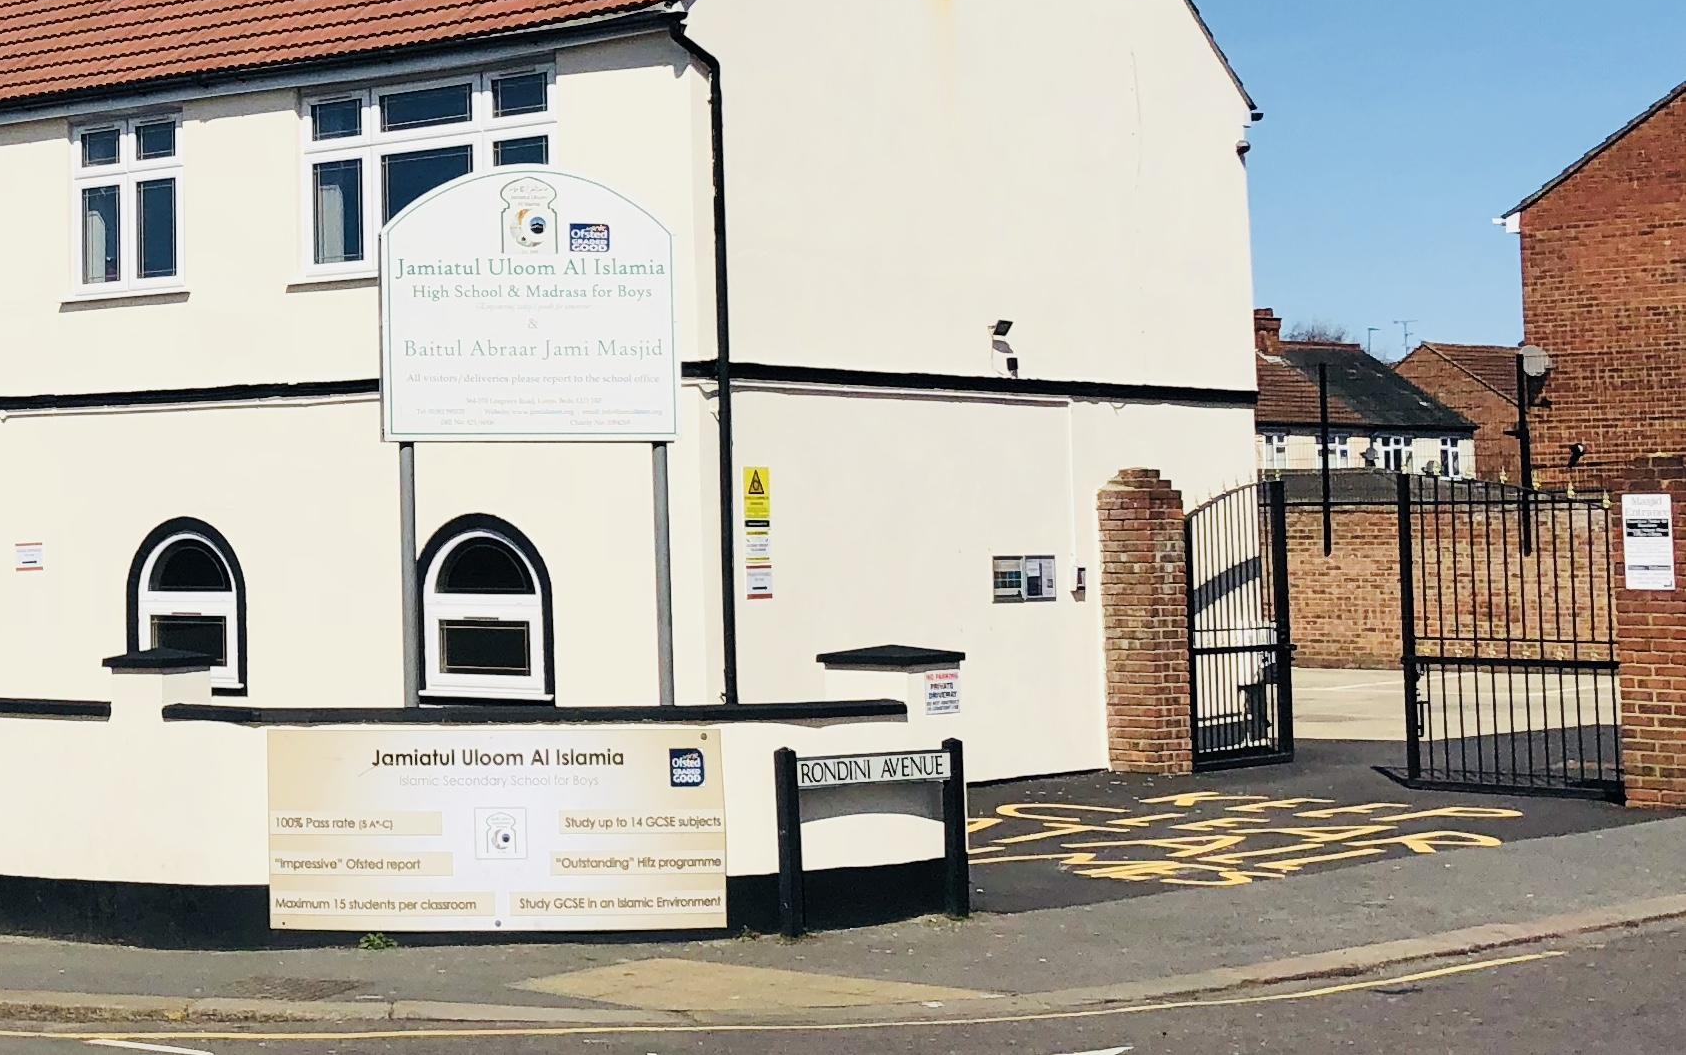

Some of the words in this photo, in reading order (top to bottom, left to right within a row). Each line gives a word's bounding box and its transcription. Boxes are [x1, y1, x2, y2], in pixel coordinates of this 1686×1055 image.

[571, 229, 607, 238] Ofsted
[396, 259, 480, 279] Jamiatul
[489, 259, 555, 275] Uloom
[564, 259, 586, 275] Al
[594, 259, 665, 275] Islamia
[413, 285, 449, 301] High
[454, 285, 502, 298] School
[509, 287, 518, 298] &
[527, 285, 586, 298] Madrasa
[593, 285, 612, 298] for
[618, 286, 651, 300] Boys
[528, 319, 538, 329] &
[404, 340, 462, 356] Baitul
[471, 340, 537, 356] Abraar
[542, 340, 588, 360] Jami
[598, 340, 662, 360] Masjid
[407, 374, 420, 382] All
[512, 374, 540, 384] please
[543, 375, 571, 384] report
[586, 374, 599, 382] the
[602, 374, 631, 383] school
[634, 374, 659, 383] office
[372, 749, 455, 767] Jamiatul
[462, 749, 523, 766] Uloom
[531, 749, 549, 766] Al
[556, 749, 624, 766] Islamia
[672, 757, 700, 767] Ofsted
[801, 760, 870, 784] RONDINI
[881, 755, 943, 777] AVENUE
[399, 775, 438, 786] Islamic
[443, 774, 506, 788] Secondary
[510, 774, 551, 786] School
[554, 774, 569, 786] for
[573, 775, 599, 788] Boys
[1140, 791, 1523, 822] KEEP
[275, 817, 303, 829] 100%
[306, 817, 329, 828] Pass
[330, 818, 356, 828] rate
[565, 816, 594, 829] Study
[598, 819, 612, 830] up
[615, 817, 626, 828] to
[631, 817, 642, 827] 14
[646, 816, 675, 827] GCSE
[679, 816, 721, 829] subjects
[996, 803, 1501, 853] CLEAR
[346, 858, 383, 870] Ofsted
[386, 859, 421, 872] report
[658, 857, 721, 870] programme
[275, 898, 331, 910] Maximum
[334, 899, 345, 910] 15
[348, 898, 396, 910] students
[399, 900, 418, 912] per
[421, 899, 476, 910] classroom
[520, 896, 549, 910] Study
[553, 897, 585, 909] GCSE
[588, 897, 599, 909] in
[601, 900, 614, 909] an
[617, 896, 652, 909] Islamic
[656, 896, 721, 908] Environment
